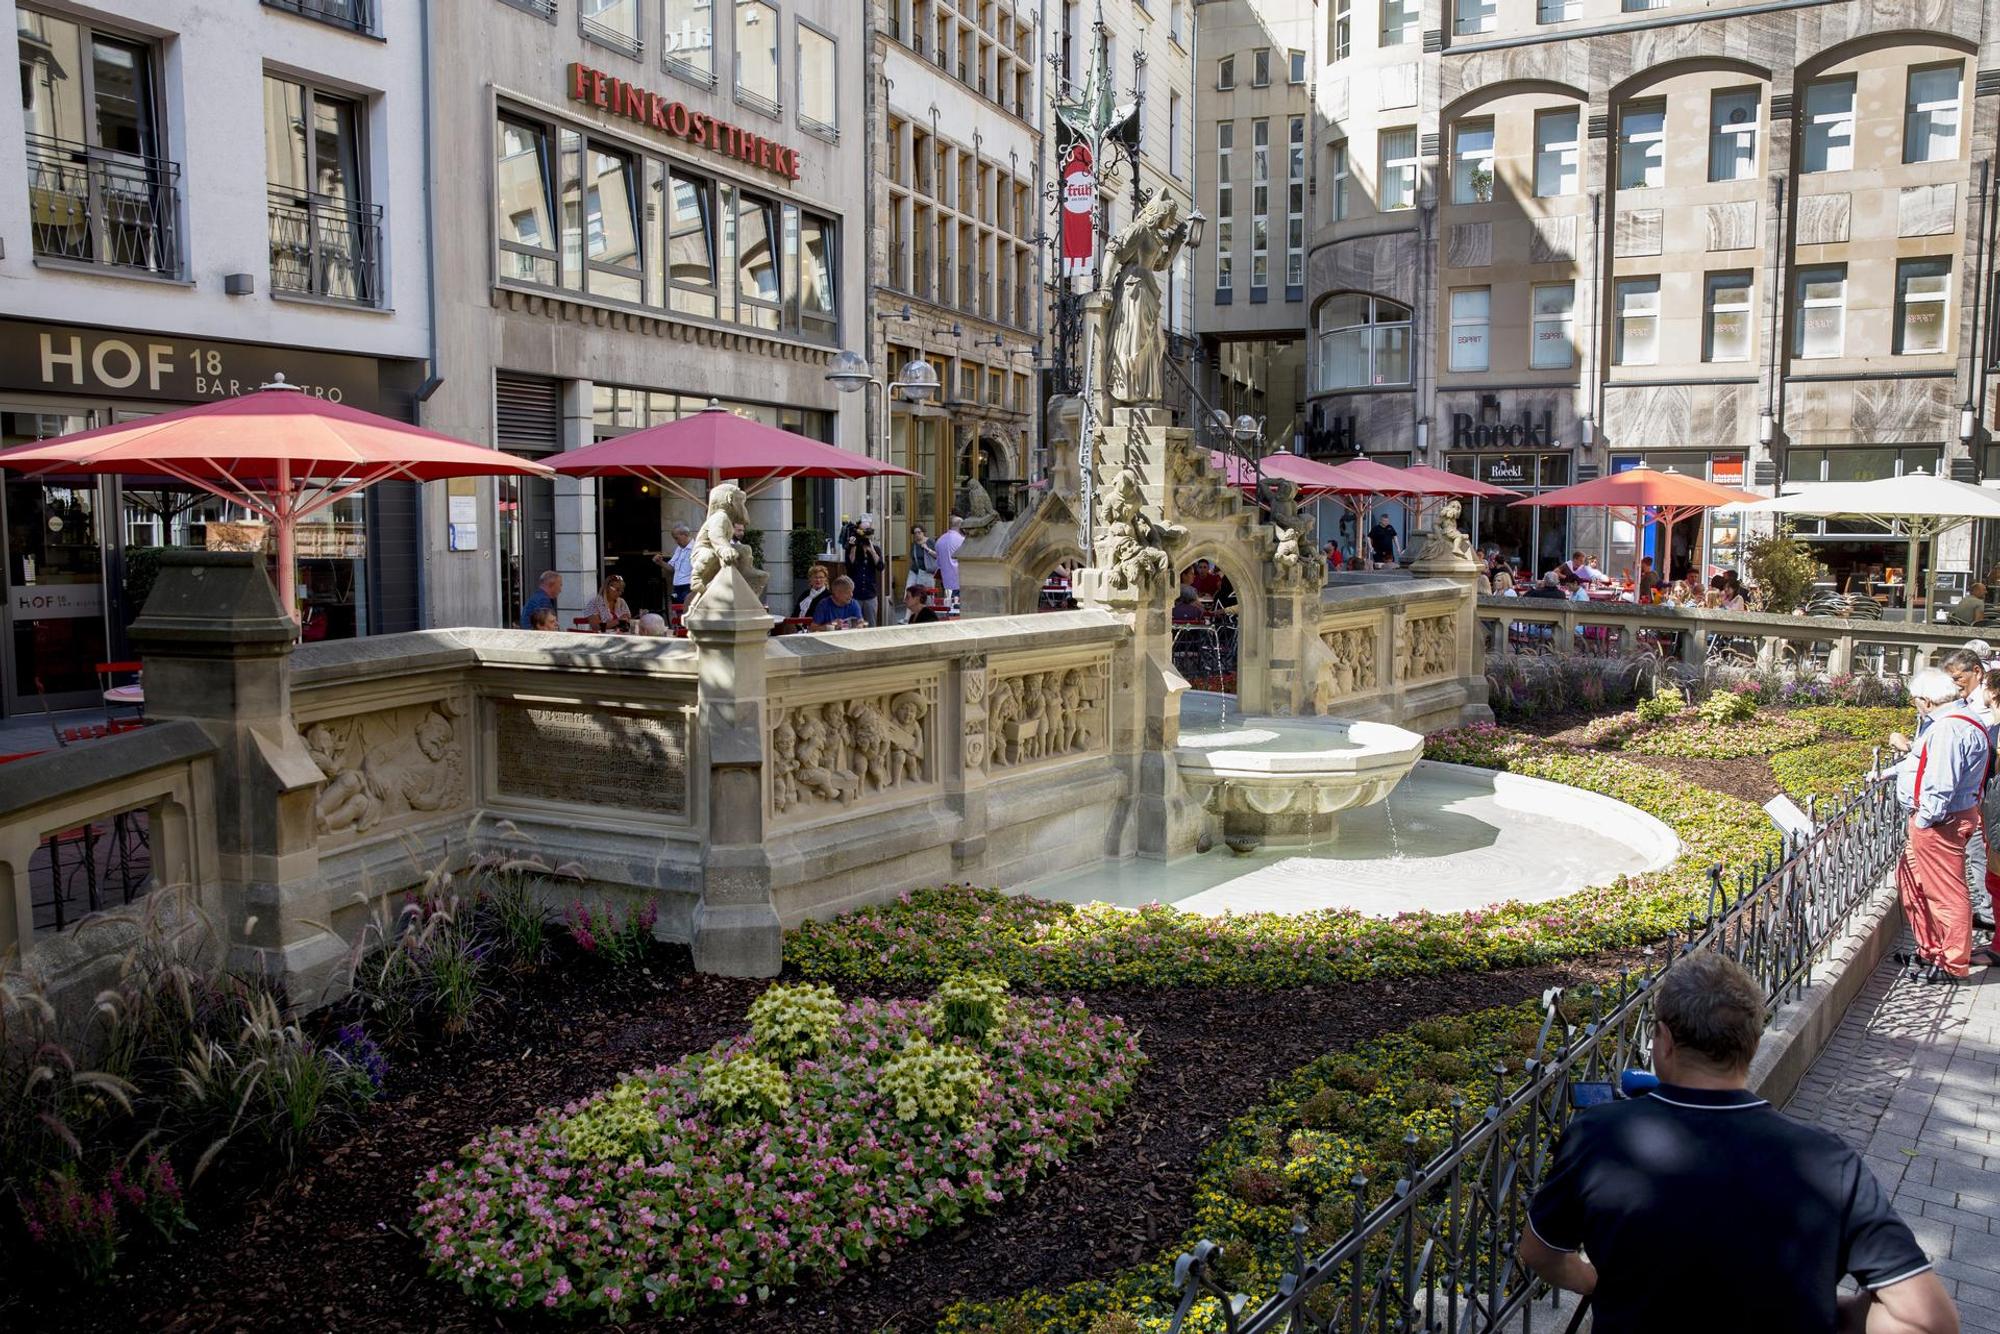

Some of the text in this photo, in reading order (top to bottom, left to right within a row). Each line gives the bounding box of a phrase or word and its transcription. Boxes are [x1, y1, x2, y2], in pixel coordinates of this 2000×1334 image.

[568, 62, 800, 180] FEINKOSTTHEKE
[1067, 184, 1092, 197] früh
[40, 333, 222, 390] HOF 18
[19, 596, 54, 609] HOF
